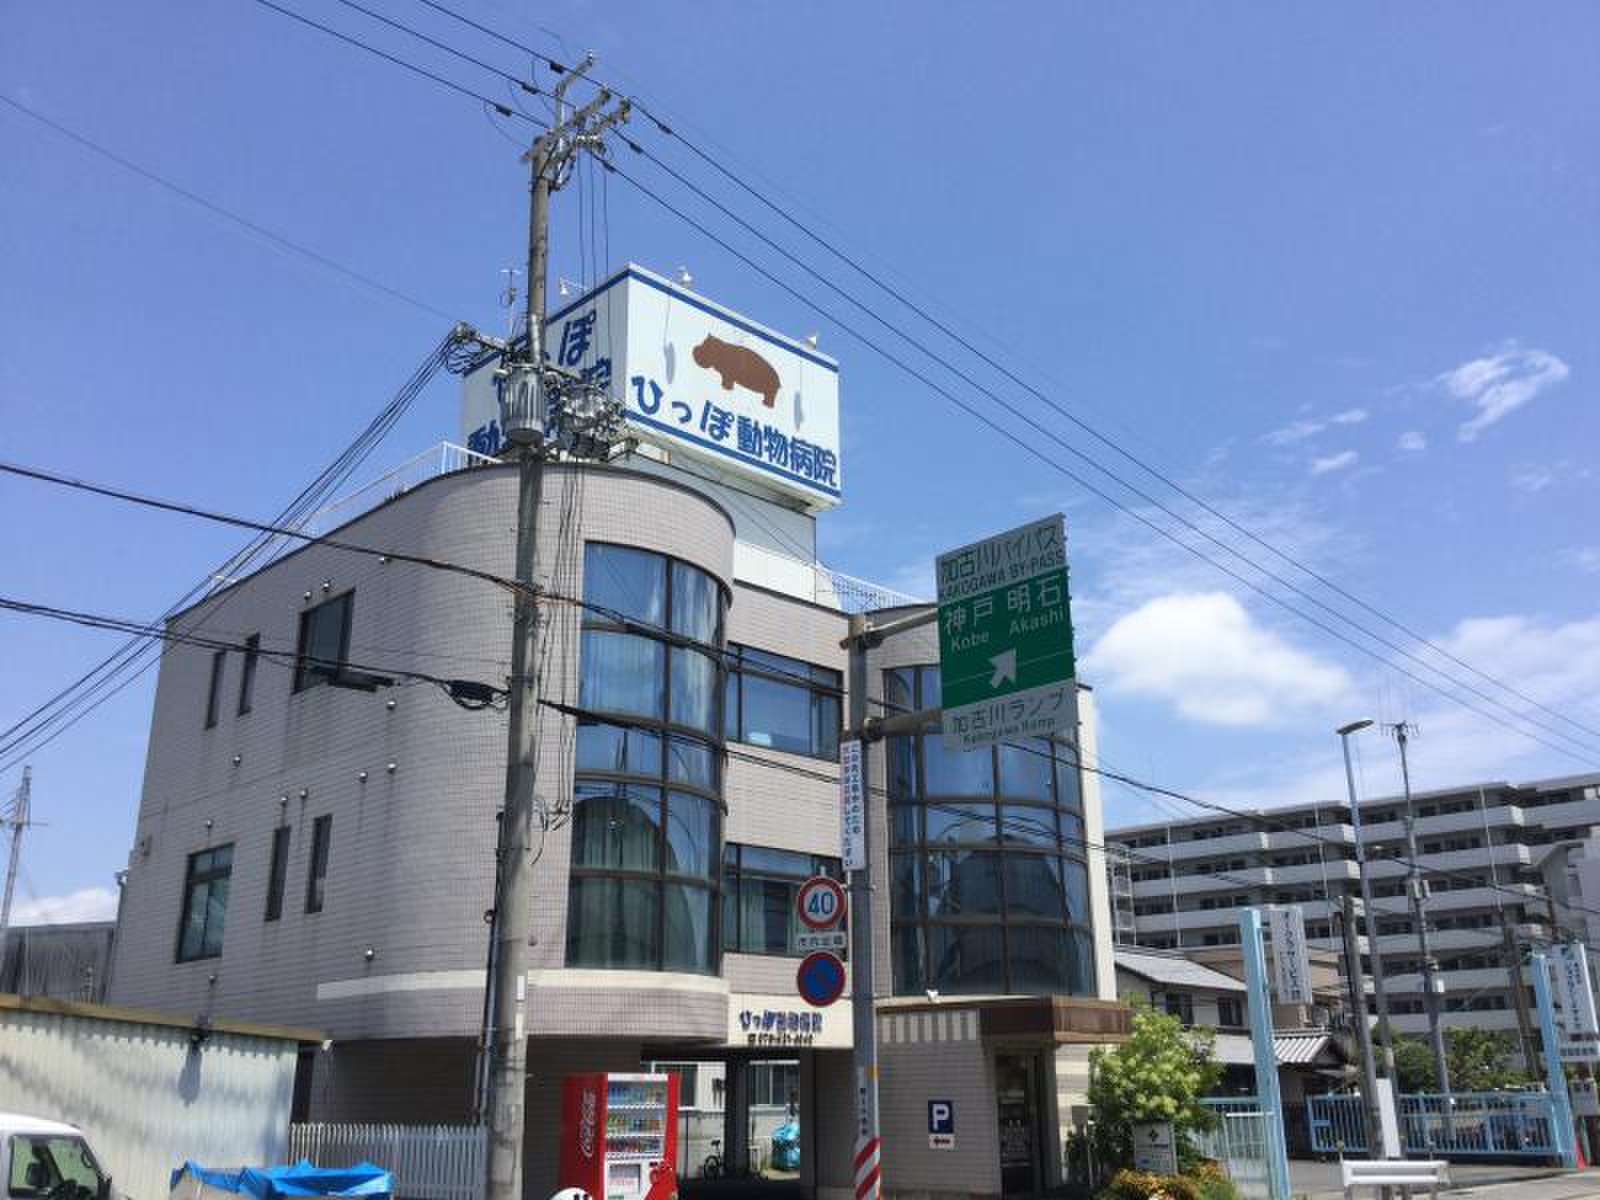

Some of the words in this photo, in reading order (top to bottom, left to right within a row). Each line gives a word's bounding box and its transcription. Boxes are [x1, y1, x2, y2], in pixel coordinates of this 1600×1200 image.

[631, 375, 838, 487] ひっぽ動物病院
[942, 526, 1059, 582] 加古川バイパス
[944, 598, 992, 634] 神戸
[1008, 576, 1061, 613] 明石
[951, 631, 989, 651] Kobe
[1009, 606, 1065, 635] Akashi
[953, 688, 1065, 732] 加古川ランプ
[808, 892, 833, 914] 40
[932, 1103, 950, 1130] P
